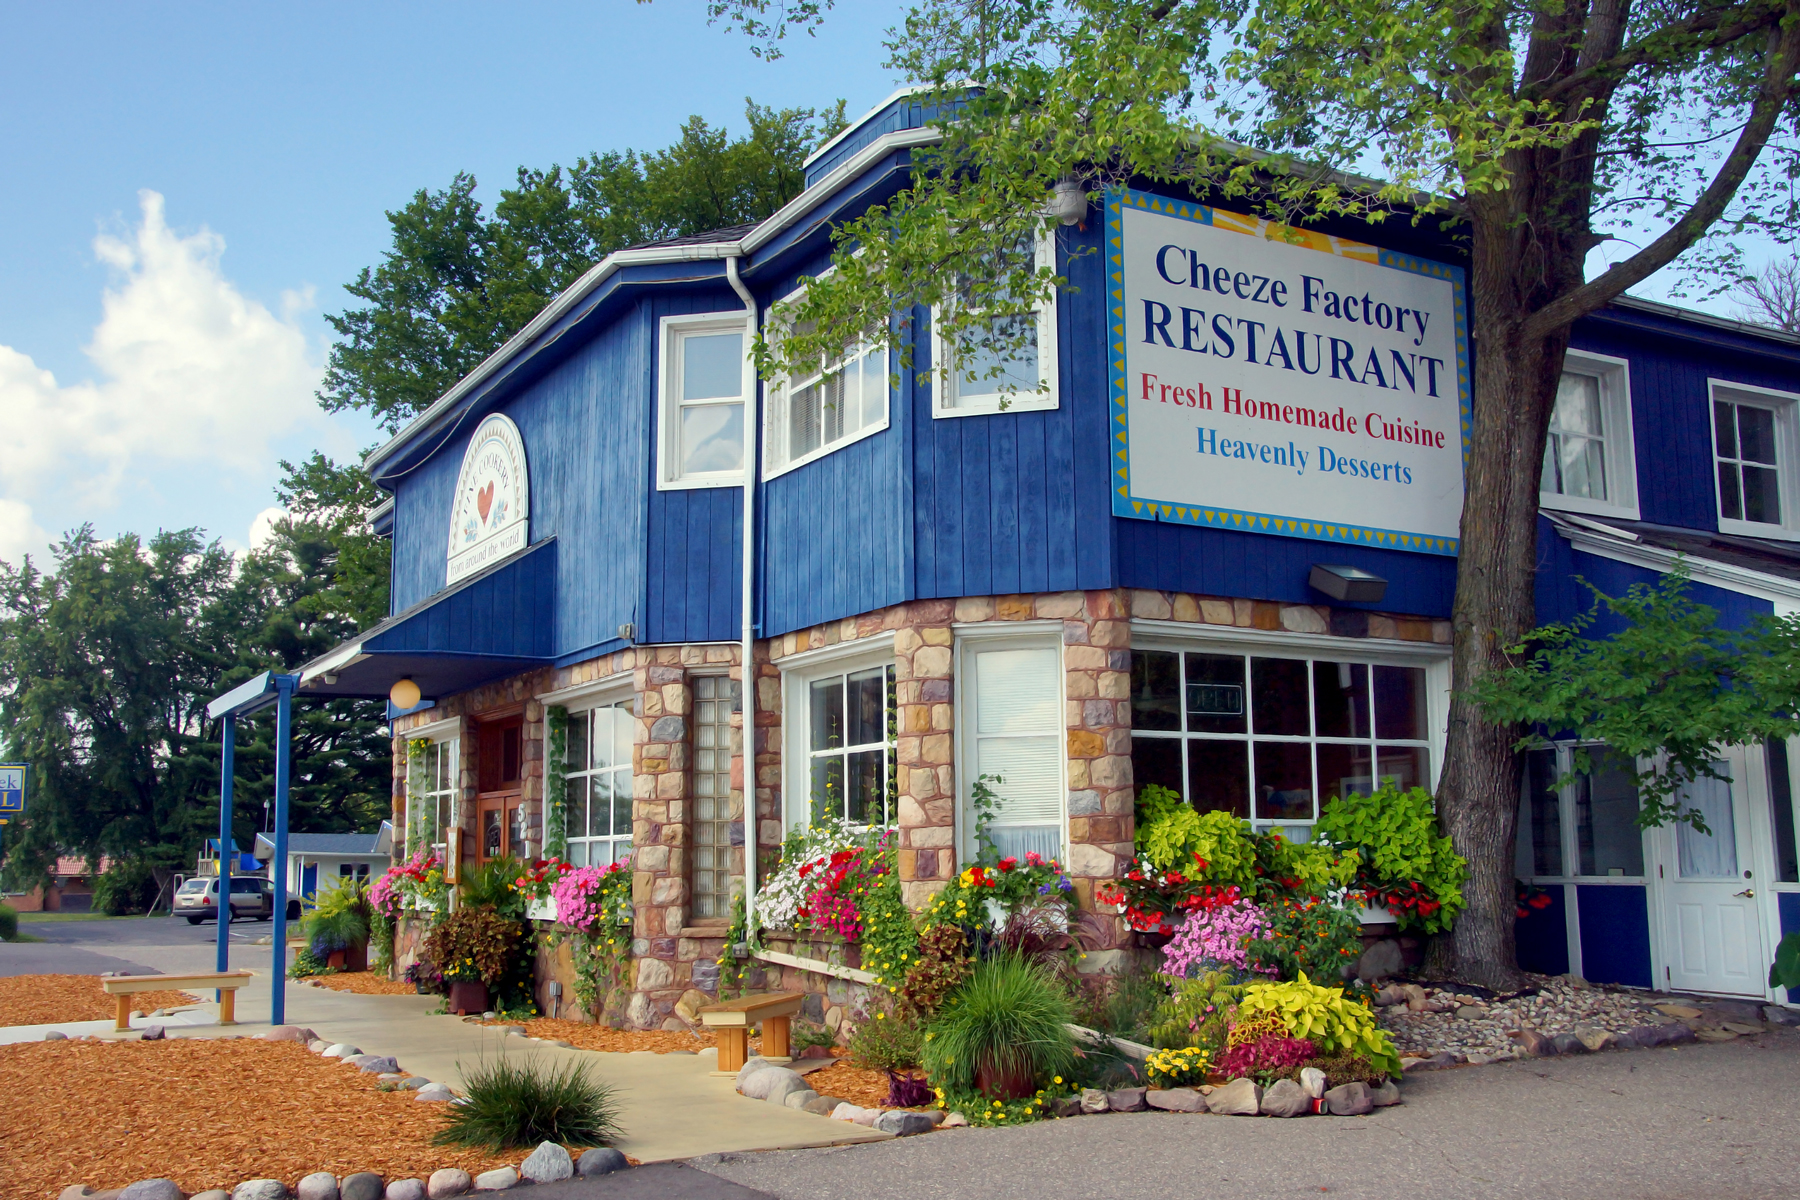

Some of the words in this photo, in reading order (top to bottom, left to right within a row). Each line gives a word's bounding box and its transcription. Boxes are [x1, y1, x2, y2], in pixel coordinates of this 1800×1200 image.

[1156, 244, 1287, 307] Cheeze
[1300, 274, 1430, 346] Factory
[1141, 299, 1443, 397] RESTAURANT
[1140, 372, 1212, 411] Fresh
[1222, 386, 1357, 434] Homemade
[1365, 412, 1445, 449] Cuisine
[464, 472, 478, 515] FINE
[479, 453, 510, 489] COOKERY
[1197, 427, 1309, 475] Heavenly
[1318, 446, 1412, 485] Desserts
[450, 560, 464, 578] from
[464, 547, 487, 569] around
[488, 541, 498, 558] the
[500, 528, 520, 551] world
